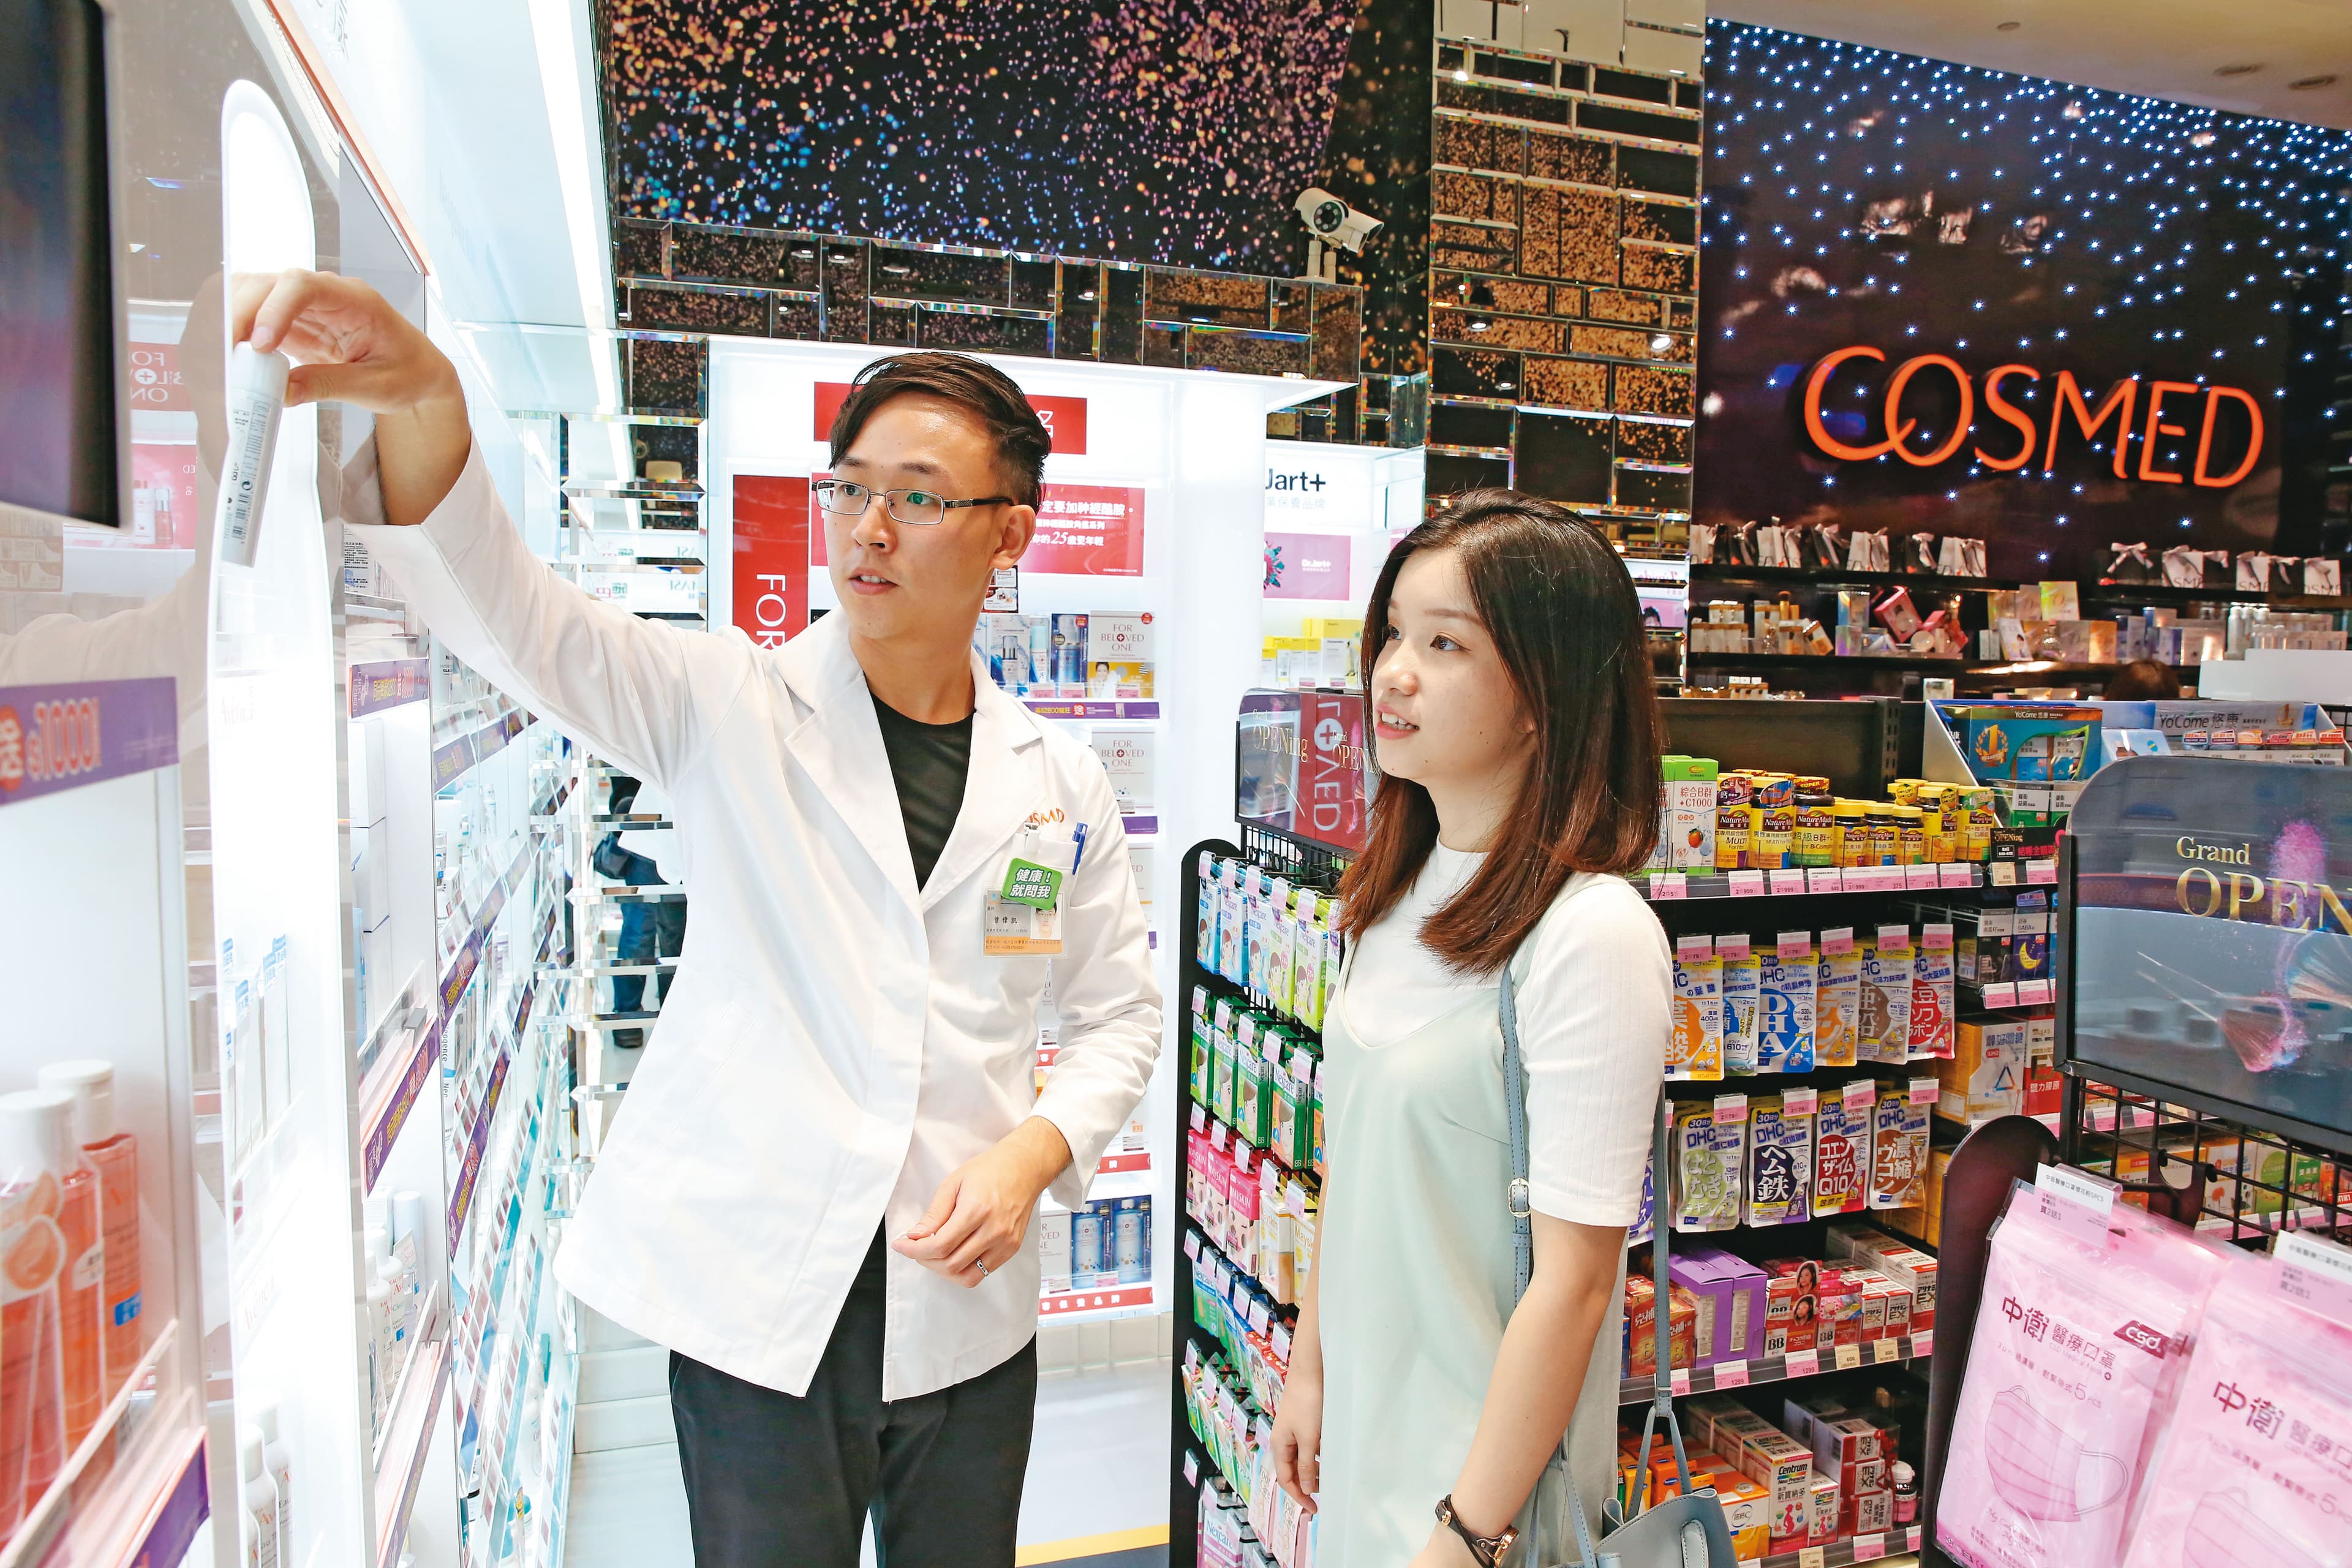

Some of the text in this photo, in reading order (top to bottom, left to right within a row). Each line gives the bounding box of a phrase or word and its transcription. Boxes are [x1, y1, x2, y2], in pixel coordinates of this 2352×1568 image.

[1804, 345, 2264, 488] COSMED
[1265, 469, 1326, 492] Jart+
[756, 573, 786, 650] FOR
[1113, 624, 1133, 633] FOR
[1111, 643, 1133, 652] ONE
[2160, 712, 2210, 729] YoCome
[2212, 713, 2239, 729] 悠康
[1113, 739, 1133, 748] FOR
[1253, 725, 1308, 763] OPENing
[1680, 786, 1713, 797] 綜合B群
[1679, 798, 1713, 807] +C1000
[1994, 834, 2024, 842] OPENing
[2176, 835, 2251, 865] Grand
[1009, 884, 1052, 899] 就問我
[1273, 919, 1290, 937] Nexcare
[1299, 930, 1316, 949] Nexcare
[1760, 967, 1785, 986] HC
[1687, 984, 1716, 997] の葉酸
[1760, 993, 1789, 1054] DHA
[1275, 1068, 1295, 1094] Nexcare
[1822, 1104, 1840, 1114] 30日分
[1882, 1100, 1899, 1109] 30日分
[1689, 1119, 1711, 1129] 30日分
[1757, 1114, 1779, 1123] 30日分
[1820, 1113, 1847, 1134] DHC
[1879, 1109, 1905, 1129] DHC
[1686, 1128, 1717, 1148] DHC
[1755, 1123, 1785, 1144] DHC
[1819, 1141, 1851, 1159] コエン
[1685, 1152, 1717, 1177] はと
[1822, 1157, 1854, 1177] ザイム
[1757, 1146, 1790, 1202] ヘム鉄
[1689, 1174, 1723, 1200] むぎ
[1818, 1176, 1849, 1196] Q10
[1230, 1184, 1251, 1209] MAYSKIN
[2040, 1204, 2062, 1221] 買2送1
[1864, 1315, 1881, 1324] EX
[1889, 1311, 1905, 1321] EX
[2001, 1295, 2050, 1343] 中衛
[1768, 1337, 1785, 1351] BB
[1819, 1330, 1834, 1343] BB
[2051, 1323, 2117, 1370] 醫療口罩
[2212, 1380, 2286, 1440] 中衛
[1777, 1463, 1807, 1476] Centrum
[1777, 1487, 1806, 1501] 新寶納多
[1815, 1491, 1835, 1500] Centrum
